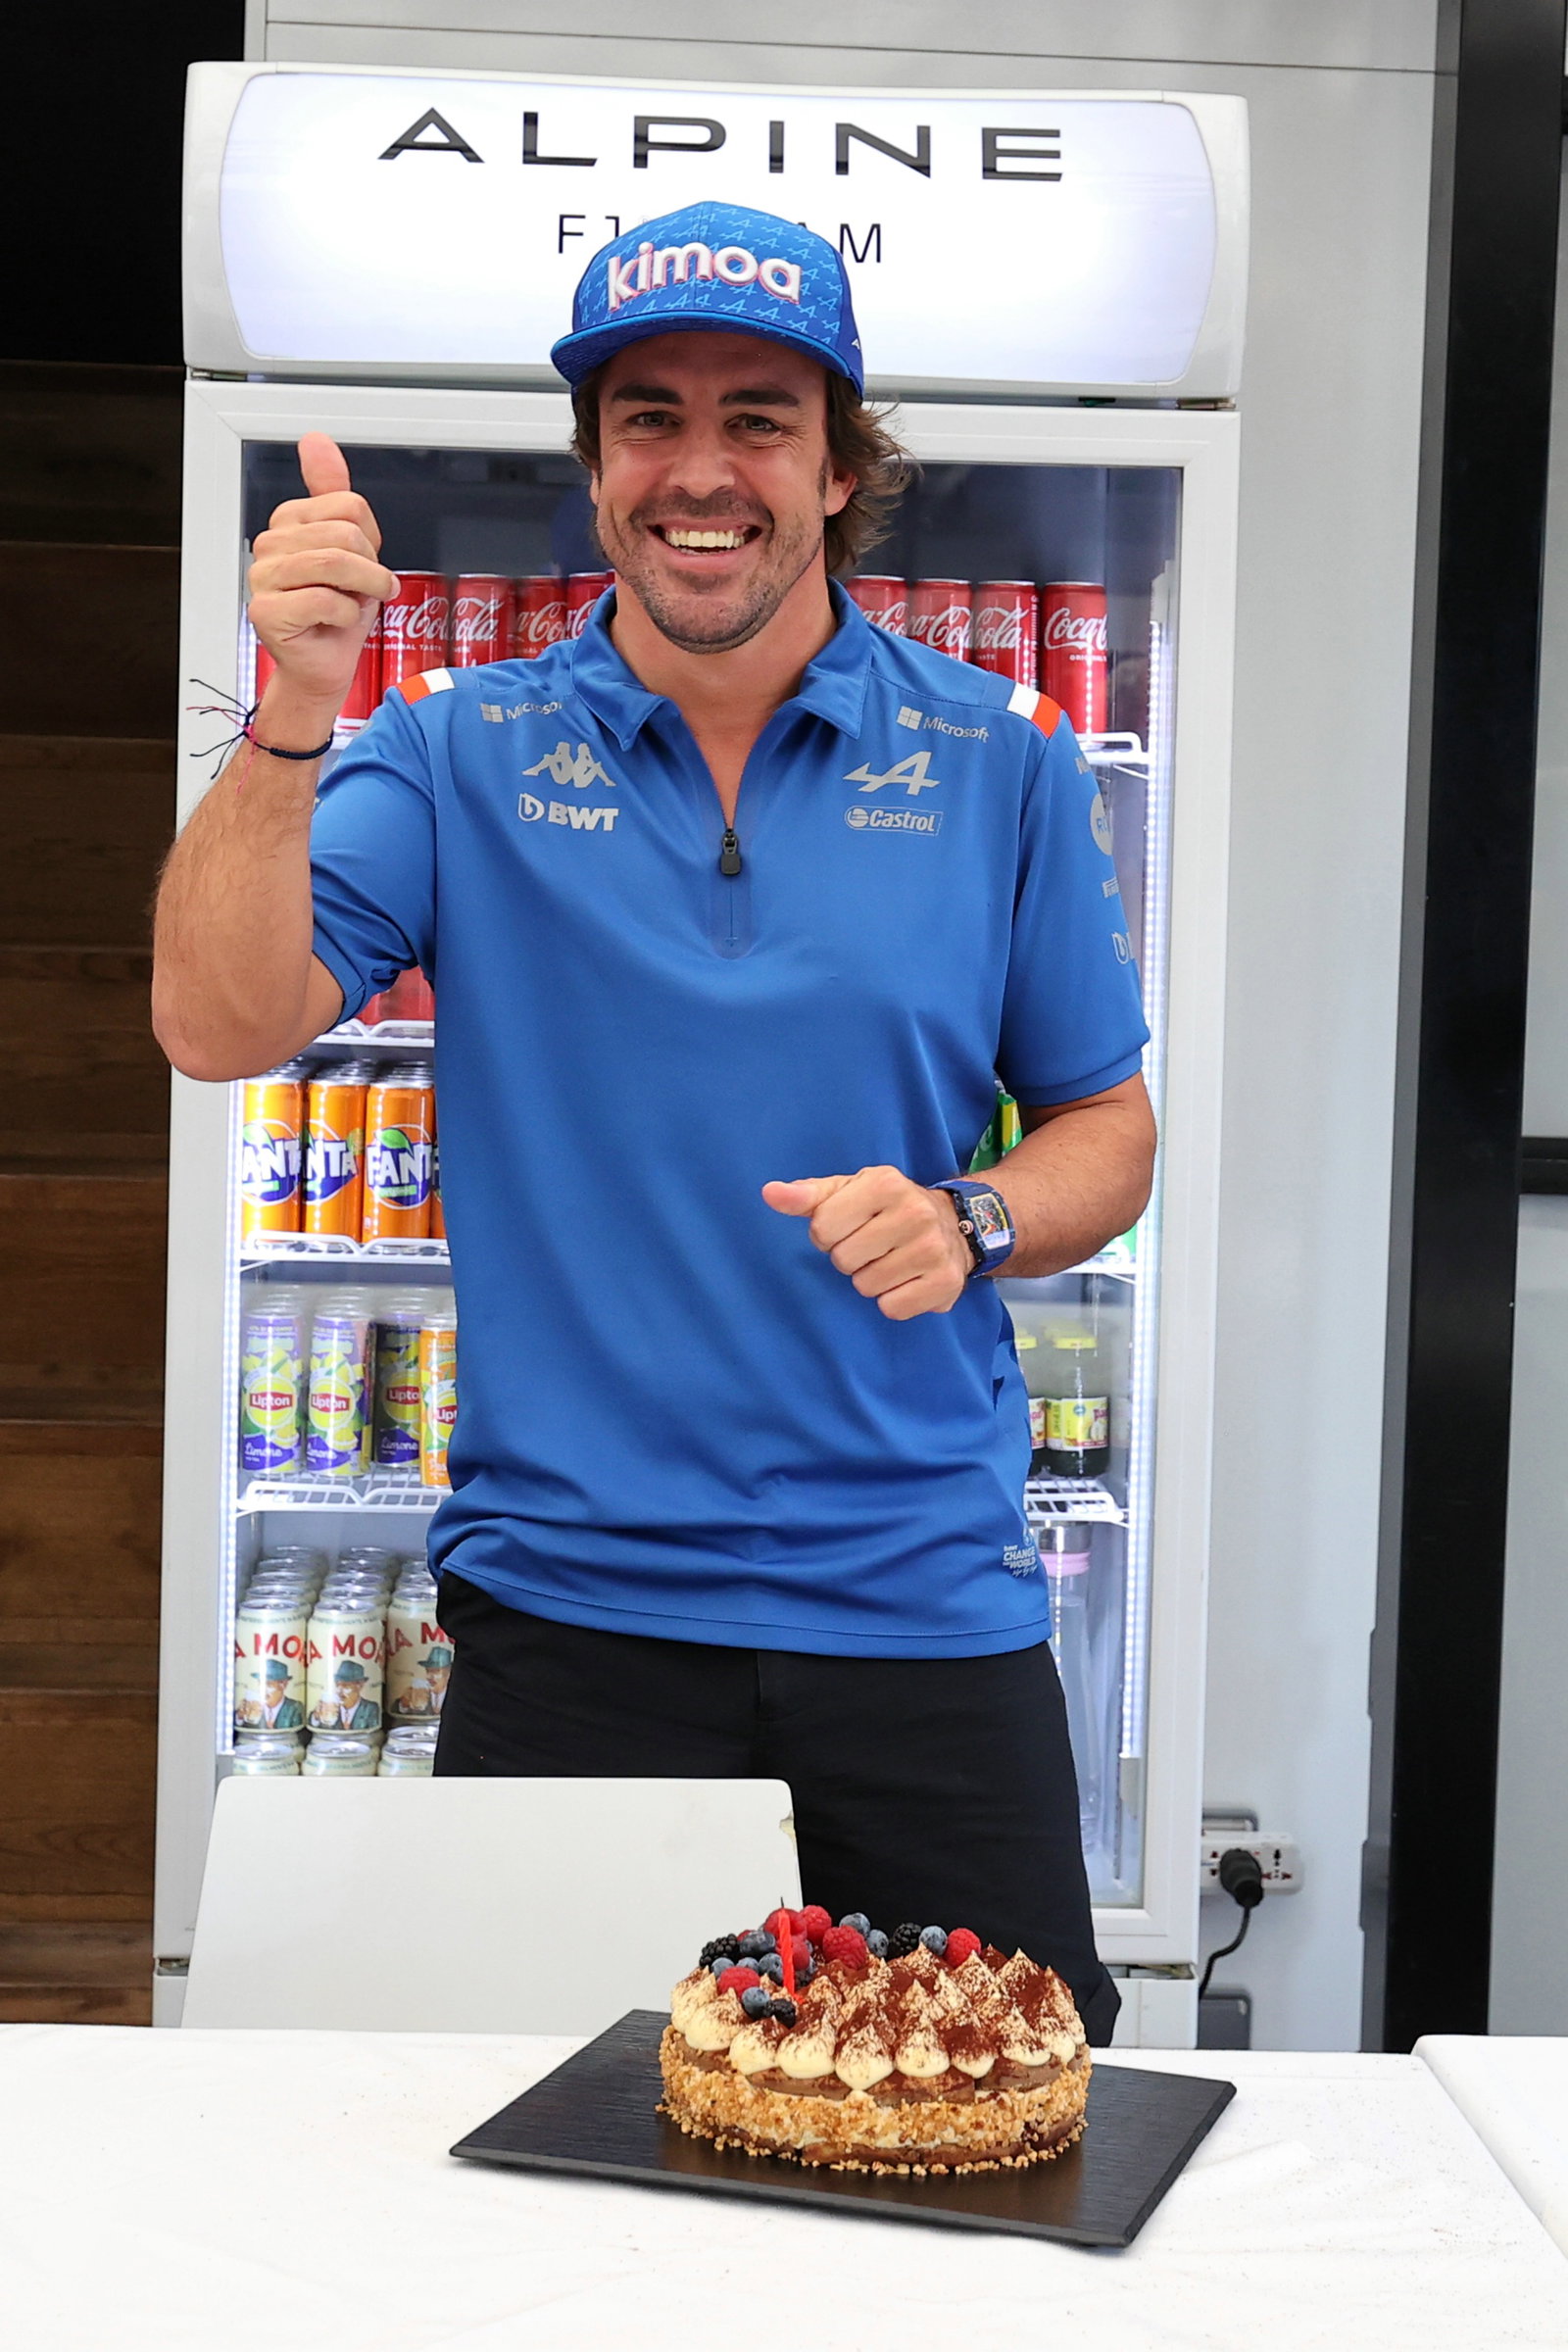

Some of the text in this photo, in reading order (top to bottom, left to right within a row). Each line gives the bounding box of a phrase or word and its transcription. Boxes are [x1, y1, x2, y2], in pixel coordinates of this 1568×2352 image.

[376, 106, 1064, 182] ALPINE
[607, 241, 803, 313] kimoa
[923, 716, 990, 744] Microsoft
[548, 801, 619, 832] BWT
[869, 808, 935, 832] Castrol
[306, 1139, 359, 1179] NTA
[366, 1143, 432, 1186] FANT
[388, 1390, 420, 1403] Lipto
